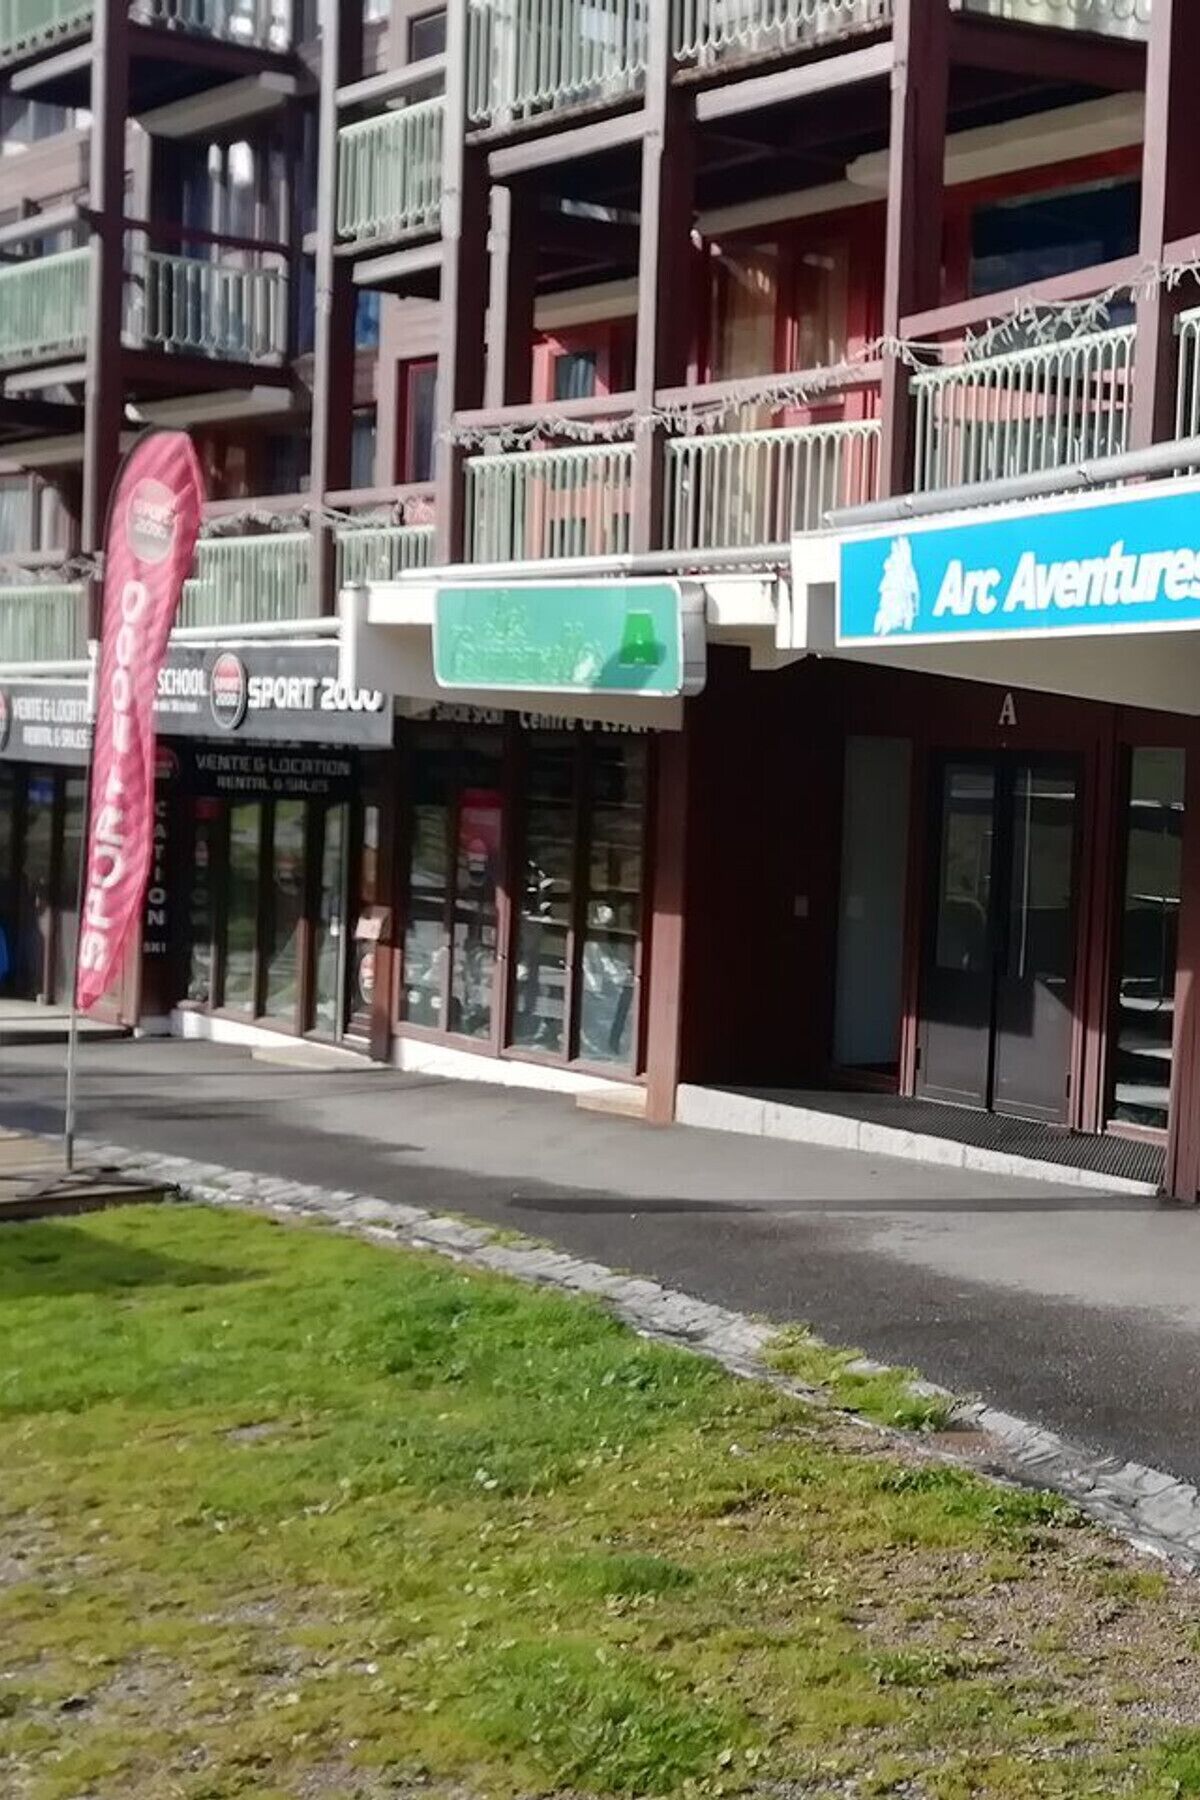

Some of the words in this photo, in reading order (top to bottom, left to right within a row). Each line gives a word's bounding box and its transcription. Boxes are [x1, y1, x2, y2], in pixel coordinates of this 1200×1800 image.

[932, 560, 1000, 616] Arc
[157, 668, 208, 696] SCHOOL
[248, 676, 317, 710] SPORT
[1000, 692, 1017, 726] A
[195, 753, 250, 772] VENTE
[268, 757, 352, 776] LOCATION
